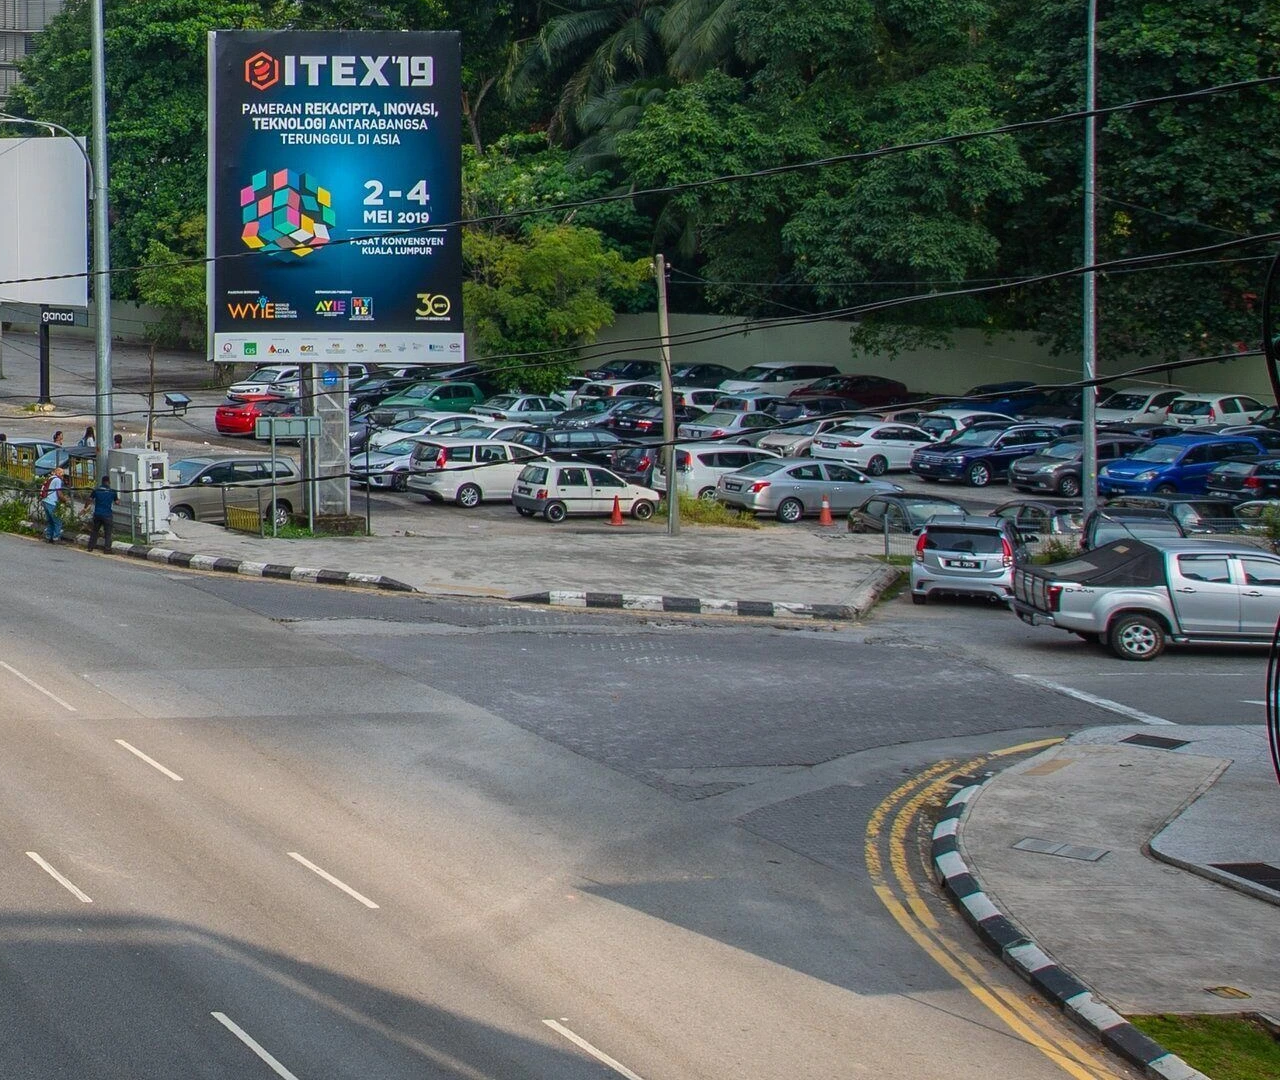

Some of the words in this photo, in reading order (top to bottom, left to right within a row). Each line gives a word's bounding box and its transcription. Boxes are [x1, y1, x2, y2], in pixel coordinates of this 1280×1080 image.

[284, 55, 434, 87] ITEX'19
[242, 103, 302, 115] PAMERAN
[304, 103, 381, 117] REKACIPTA,
[383, 103, 439, 117] INOVASI,
[252, 118, 326, 130] TEKNOLOGI
[329, 118, 428, 130] ANTARABANGSA
[280, 133, 355, 145] TERUNGGUL
[357, 133, 370, 145] DI
[373, 133, 401, 145] ASIA
[363, 210, 393, 224] MEI
[397, 212, 429, 224] 2019
[378, 237, 444, 247] KONVENSYEN
[361, 246, 392, 255] KUALA
[395, 246, 432, 256] LUMPUR
[42, 309, 74, 322] ganad
